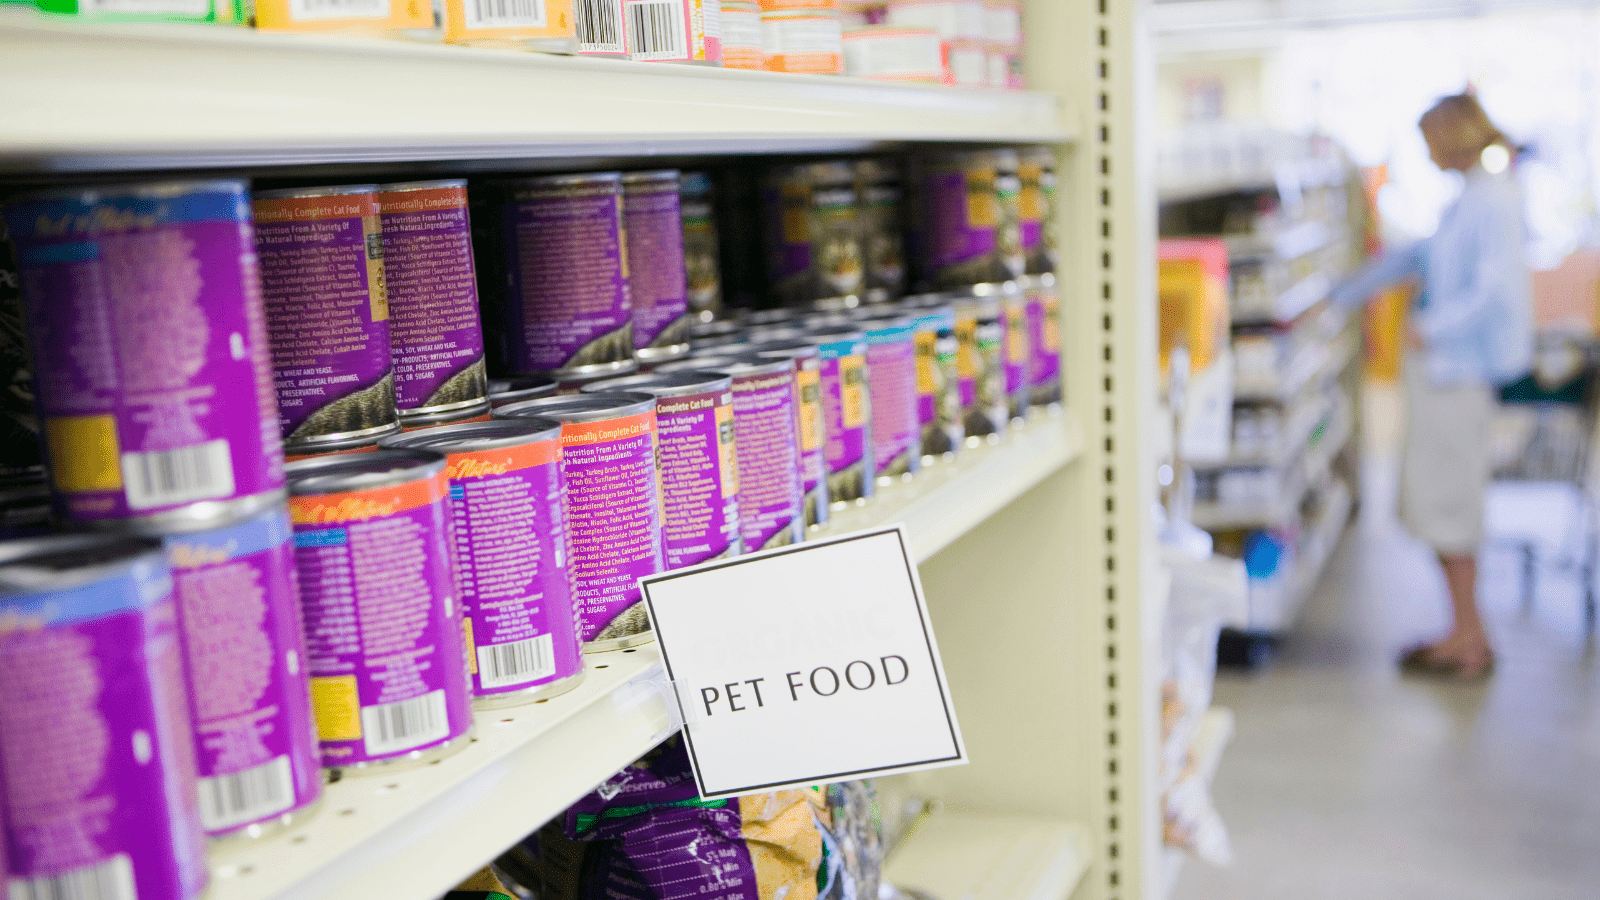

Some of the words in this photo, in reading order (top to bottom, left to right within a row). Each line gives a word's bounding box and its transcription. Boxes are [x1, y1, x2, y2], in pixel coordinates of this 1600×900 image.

[295, 205, 331, 219] Complete
[334, 206, 345, 214] Cat
[346, 204, 360, 214] Food
[380, 199, 423, 214] utritionally
[392, 215, 420, 224] Nutrition
[422, 214, 436, 222] From
[257, 226, 289, 236] Nutrition
[292, 225, 310, 234] From
[317, 222, 341, 234] Variety
[401, 223, 422, 232] Natural
[266, 235, 292, 244] Natural
[294, 232, 335, 245] Ingredients
[415, 371, 434, 380] SUGARS
[282, 398, 303, 407] SUGARS
[599, 427, 629, 440] Complete
[631, 425, 639, 434] Cat
[565, 447, 594, 458] Nutrition
[596, 445, 611, 454] From
[618, 441, 636, 451] Variety
[573, 455, 596, 465] Natural
[599, 450, 632, 463] Ingredients
[588, 578, 605, 586] WHEAT
[607, 576, 617, 584] AND
[603, 584, 627, 595] ARTIFICIAL
[588, 593, 626, 606] PRESERVATIVES,
[587, 605, 606, 615] SUGARS
[700, 677, 764, 716] PET
[786, 654, 910, 702] FOOD
